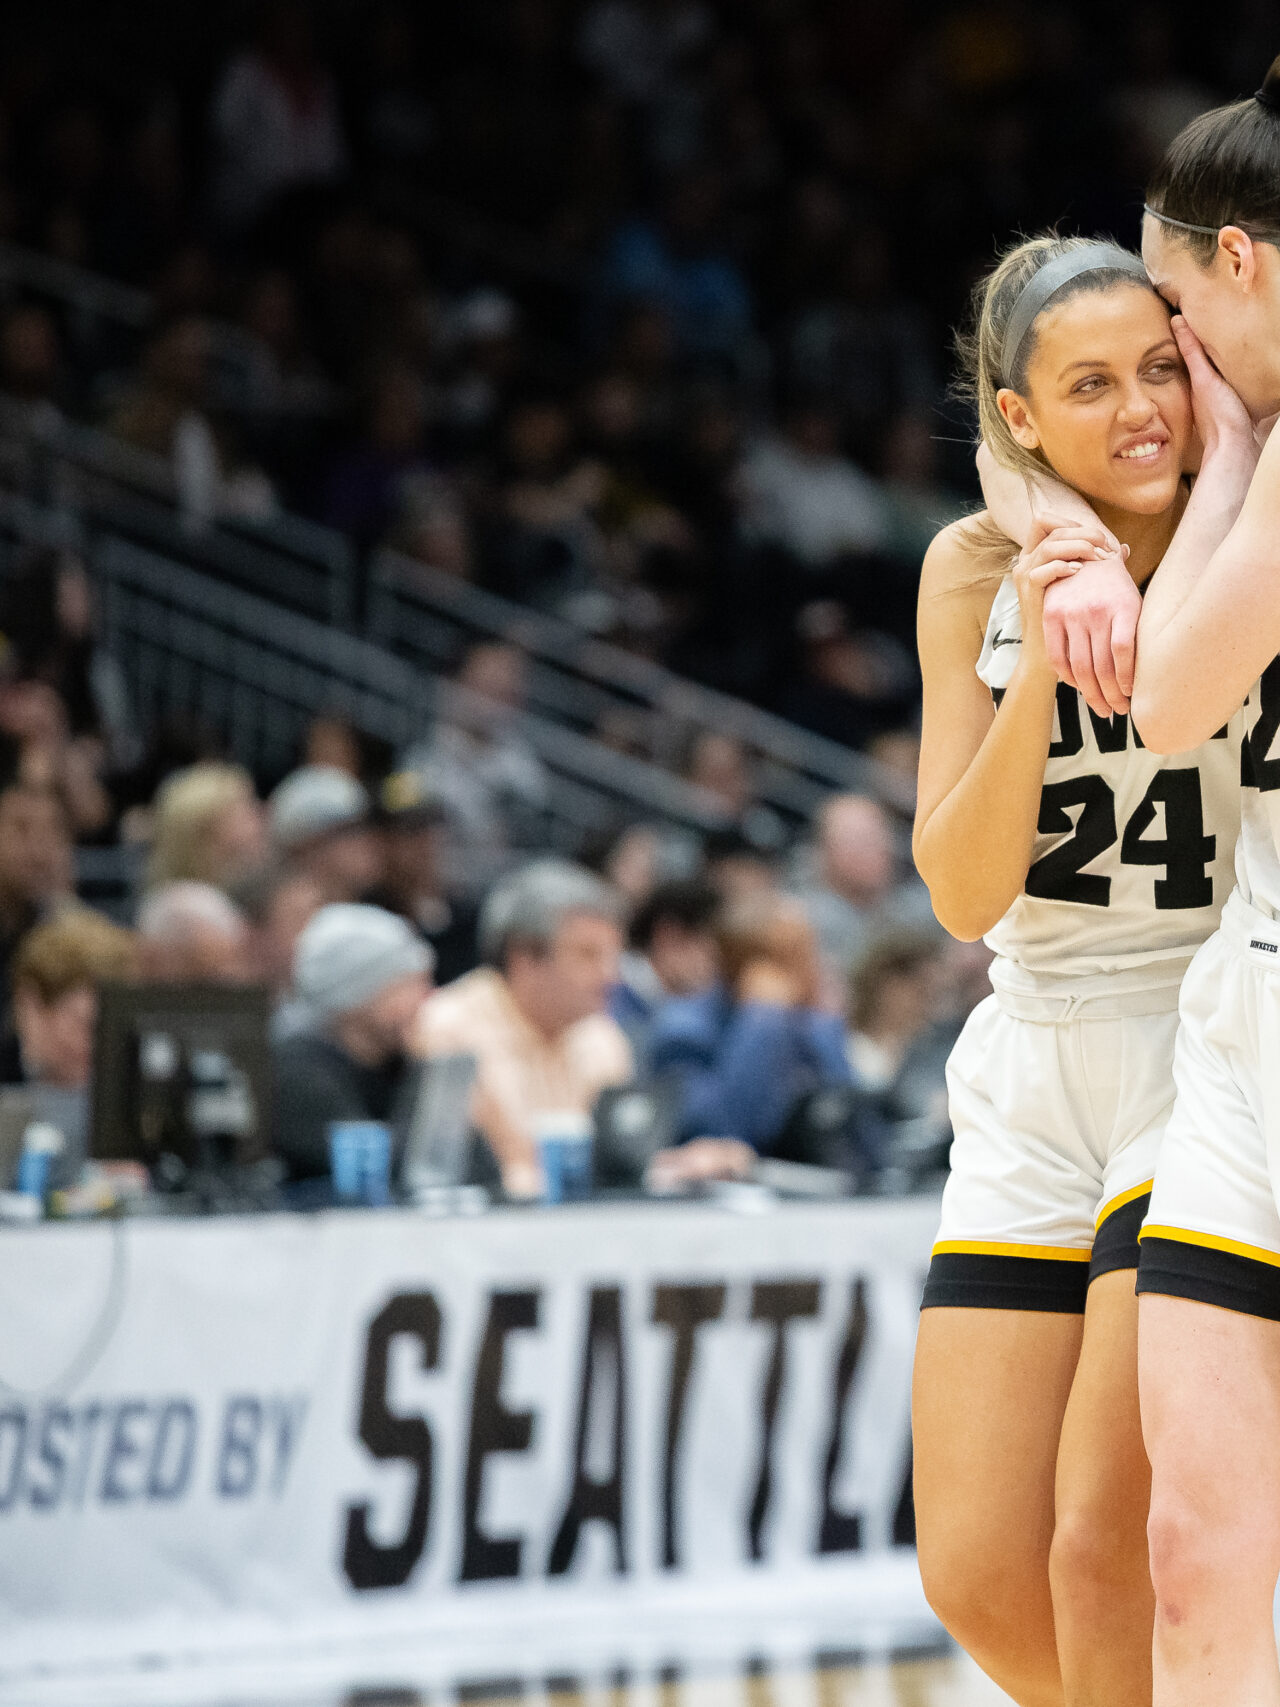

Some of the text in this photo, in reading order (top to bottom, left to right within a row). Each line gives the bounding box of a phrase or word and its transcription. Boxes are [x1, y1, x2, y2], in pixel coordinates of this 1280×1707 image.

[1025, 766, 1216, 909] 24
[216, 1394, 309, 1502] BY
[342, 1275, 918, 1592] SEATTL
